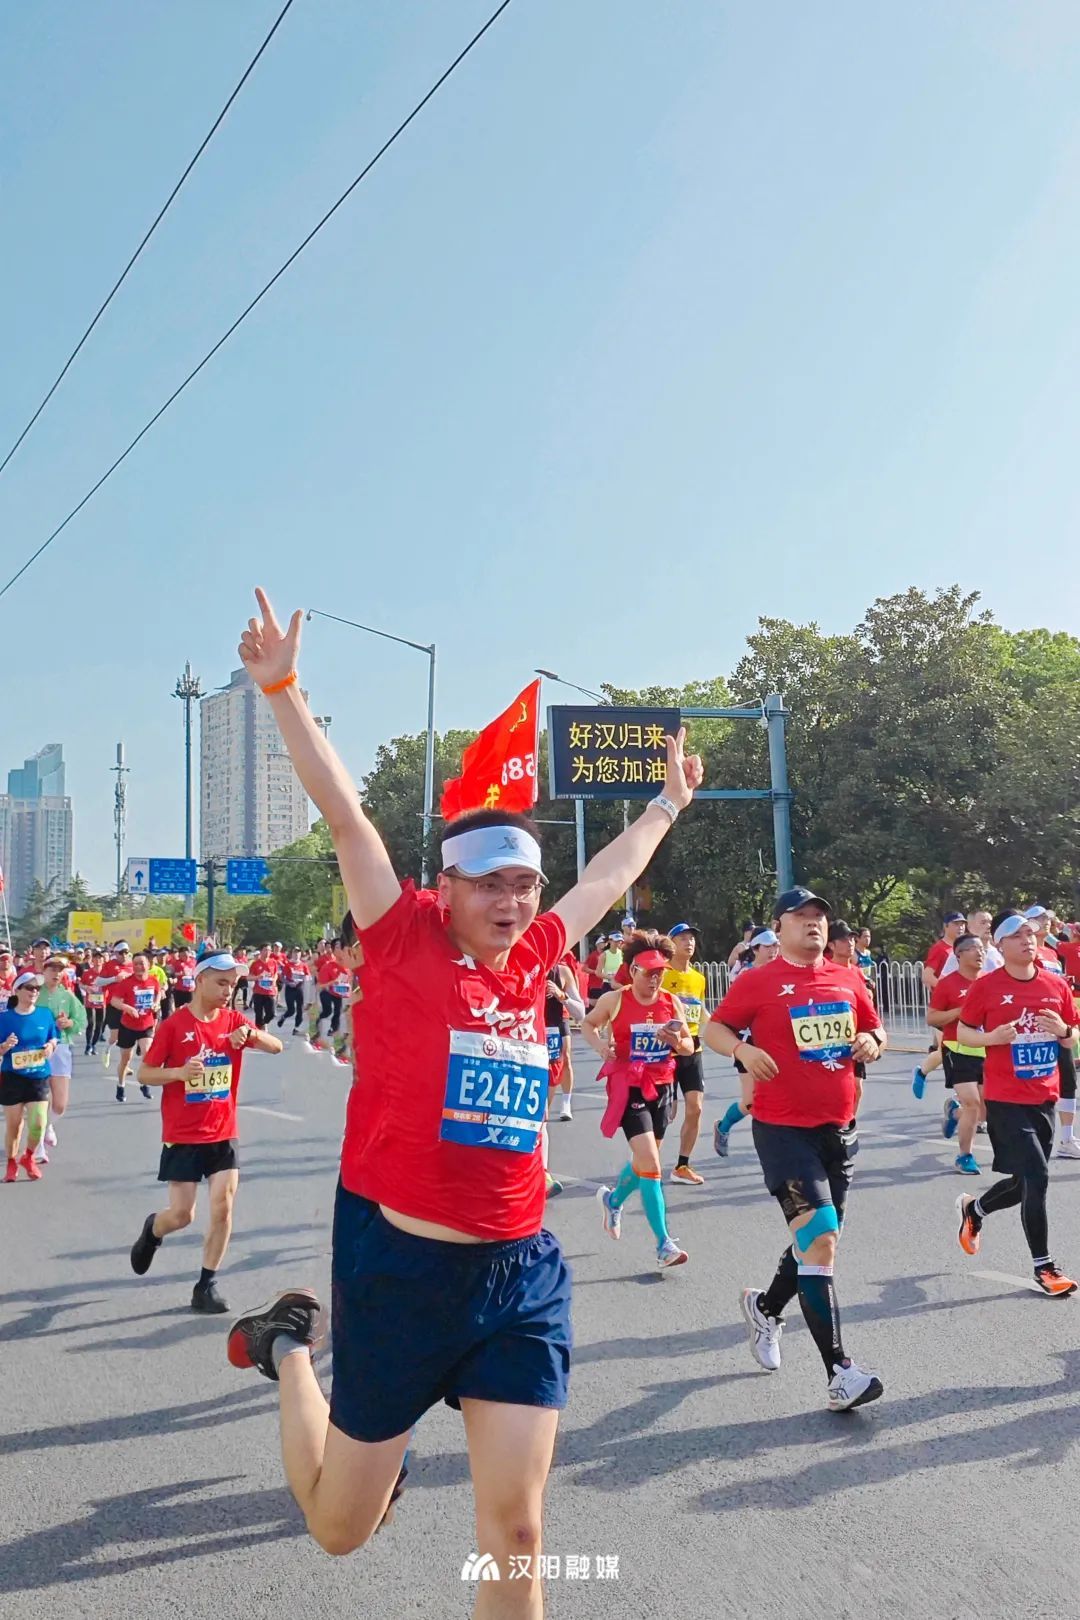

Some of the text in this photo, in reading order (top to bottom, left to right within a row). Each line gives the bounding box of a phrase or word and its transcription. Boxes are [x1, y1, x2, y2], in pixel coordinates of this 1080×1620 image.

[569, 722, 667, 749] 好汉归来
[571, 755, 668, 784] 为您加油
[547, 1037, 559, 1049] 39
[799, 1020, 852, 1043] C1296
[1017, 1046, 1055, 1065] E1476
[458, 1069, 541, 1115] E2475
